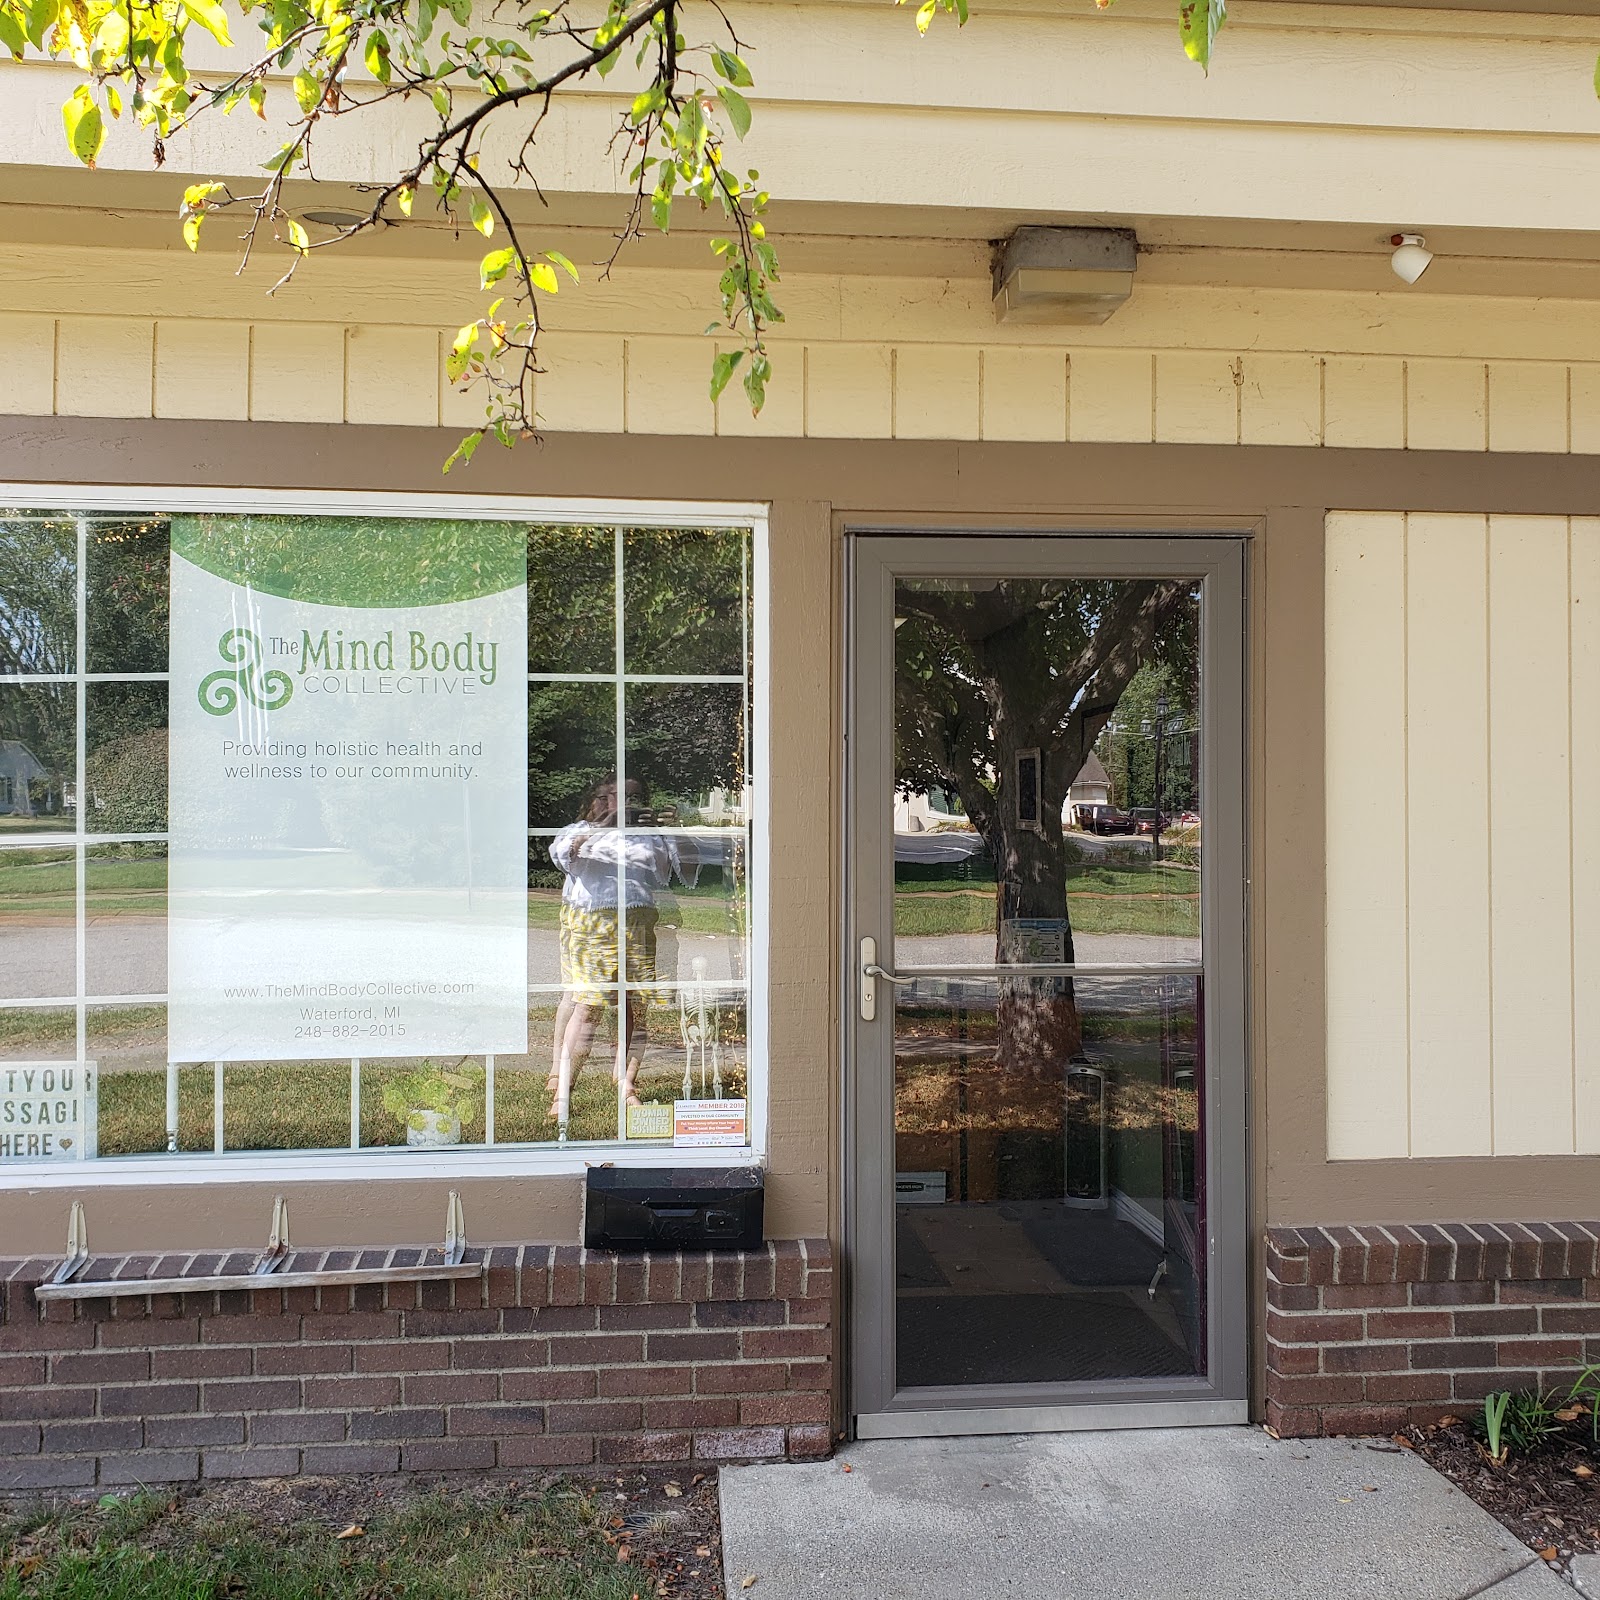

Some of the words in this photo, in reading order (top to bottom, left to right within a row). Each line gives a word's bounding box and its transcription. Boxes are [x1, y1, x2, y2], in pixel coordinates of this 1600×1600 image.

[269, 637, 299, 655] The
[297, 629, 396, 675] Mind
[408, 630, 499, 686] Body
[303, 676, 476, 695] COLLECTIVE
[223, 740, 307, 758] Providing
[315, 740, 379, 757] holistic
[386, 740, 441, 756] health
[449, 740, 483, 756] and
[224, 763, 302, 779] wellness
[310, 765, 328, 778] to
[335, 767, 364, 779] our
[371, 763, 479, 780] community.
[224, 982, 475, 998] www.TheMindBodyCollective.com
[300, 1007, 377, 1021] Waterford,
[384, 1007, 400, 1019] MI
[294, 1024, 406, 1038] 248-882-2015
[632, 1108, 669, 1118] WOMAN
[632, 1117, 669, 1126] OWNED
[632, 1125, 669, 1134] BUSINESS
[0, 1133, 53, 1156] HERE
